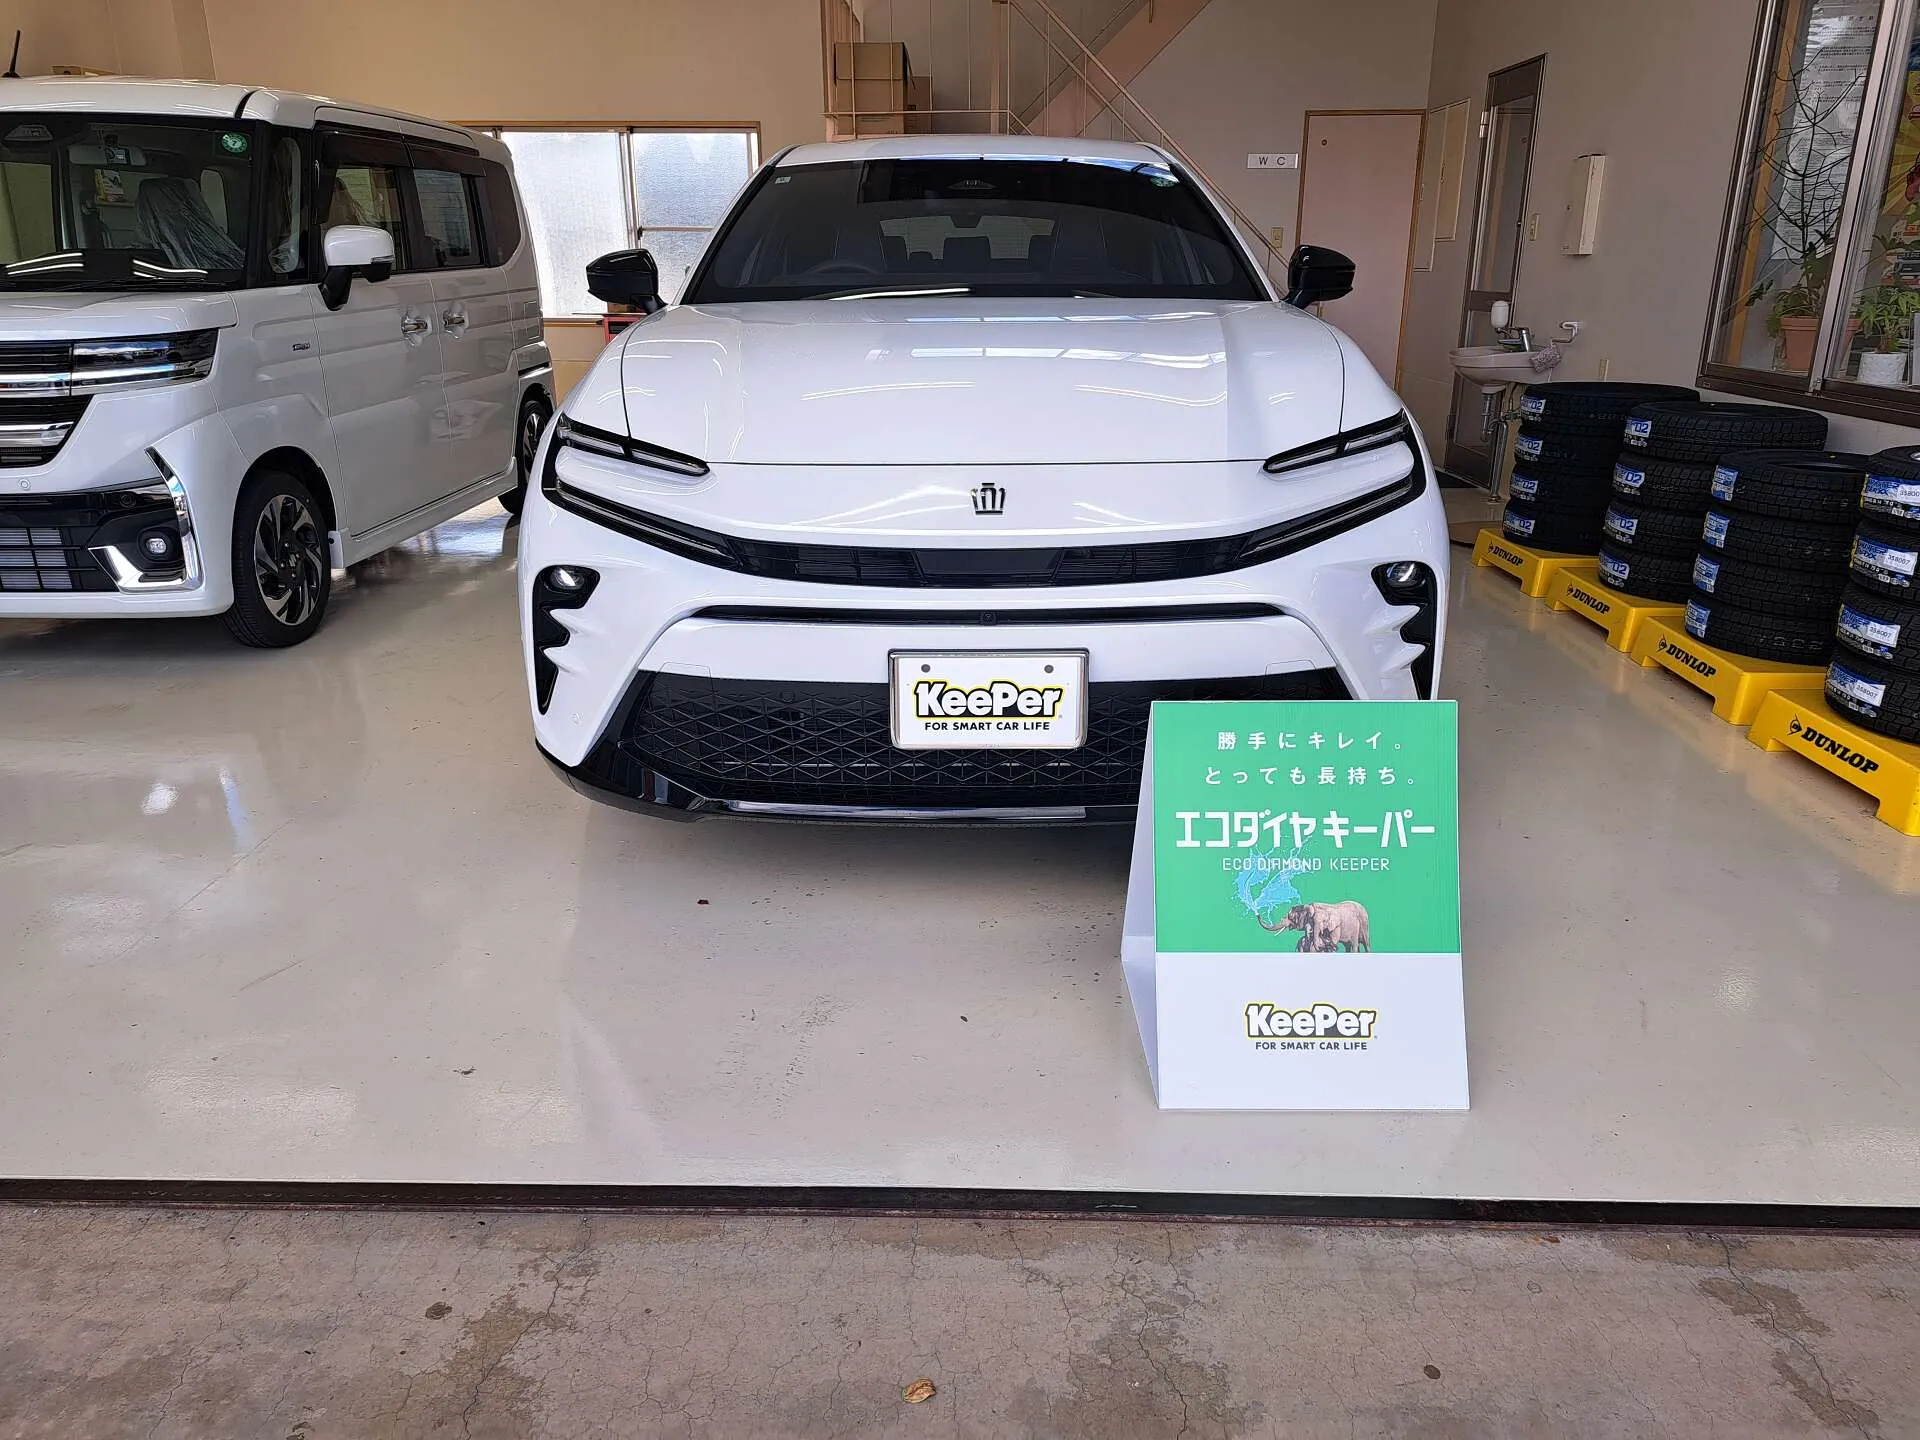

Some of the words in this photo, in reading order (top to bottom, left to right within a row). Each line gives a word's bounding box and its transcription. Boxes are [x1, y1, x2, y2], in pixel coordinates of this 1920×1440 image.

[1493, 545, 1524, 567] DUNLOP
[1572, 587, 1612, 615] DUNLOP
[1666, 643, 1717, 678] DUNLOP
[913, 680, 1063, 718] KeePer
[924, 721, 949, 731] FOR
[952, 721, 992, 731] SMART
[996, 721, 1019, 731] CAR
[1023, 721, 1050, 731] LIFE
[1217, 731, 1402, 751] 勝手にキレイ。
[1801, 726, 1880, 774] DUNLOP
[1204, 766, 1414, 785] とっても長持ち。
[1175, 808, 1436, 849] エコダイヤキーパー
[1222, 857, 1252, 871] ECO
[1257, 857, 1322, 871] DIAMOND
[1329, 857, 1390, 871] KEEPER
[1245, 1003, 1377, 1038] KeePer
[1255, 1041, 1277, 1050] FOR
[1280, 1041, 1316, 1050] SMART
[1319, 1041, 1340, 1050] CAR
[1343, 1041, 1367, 1050] LIFE
